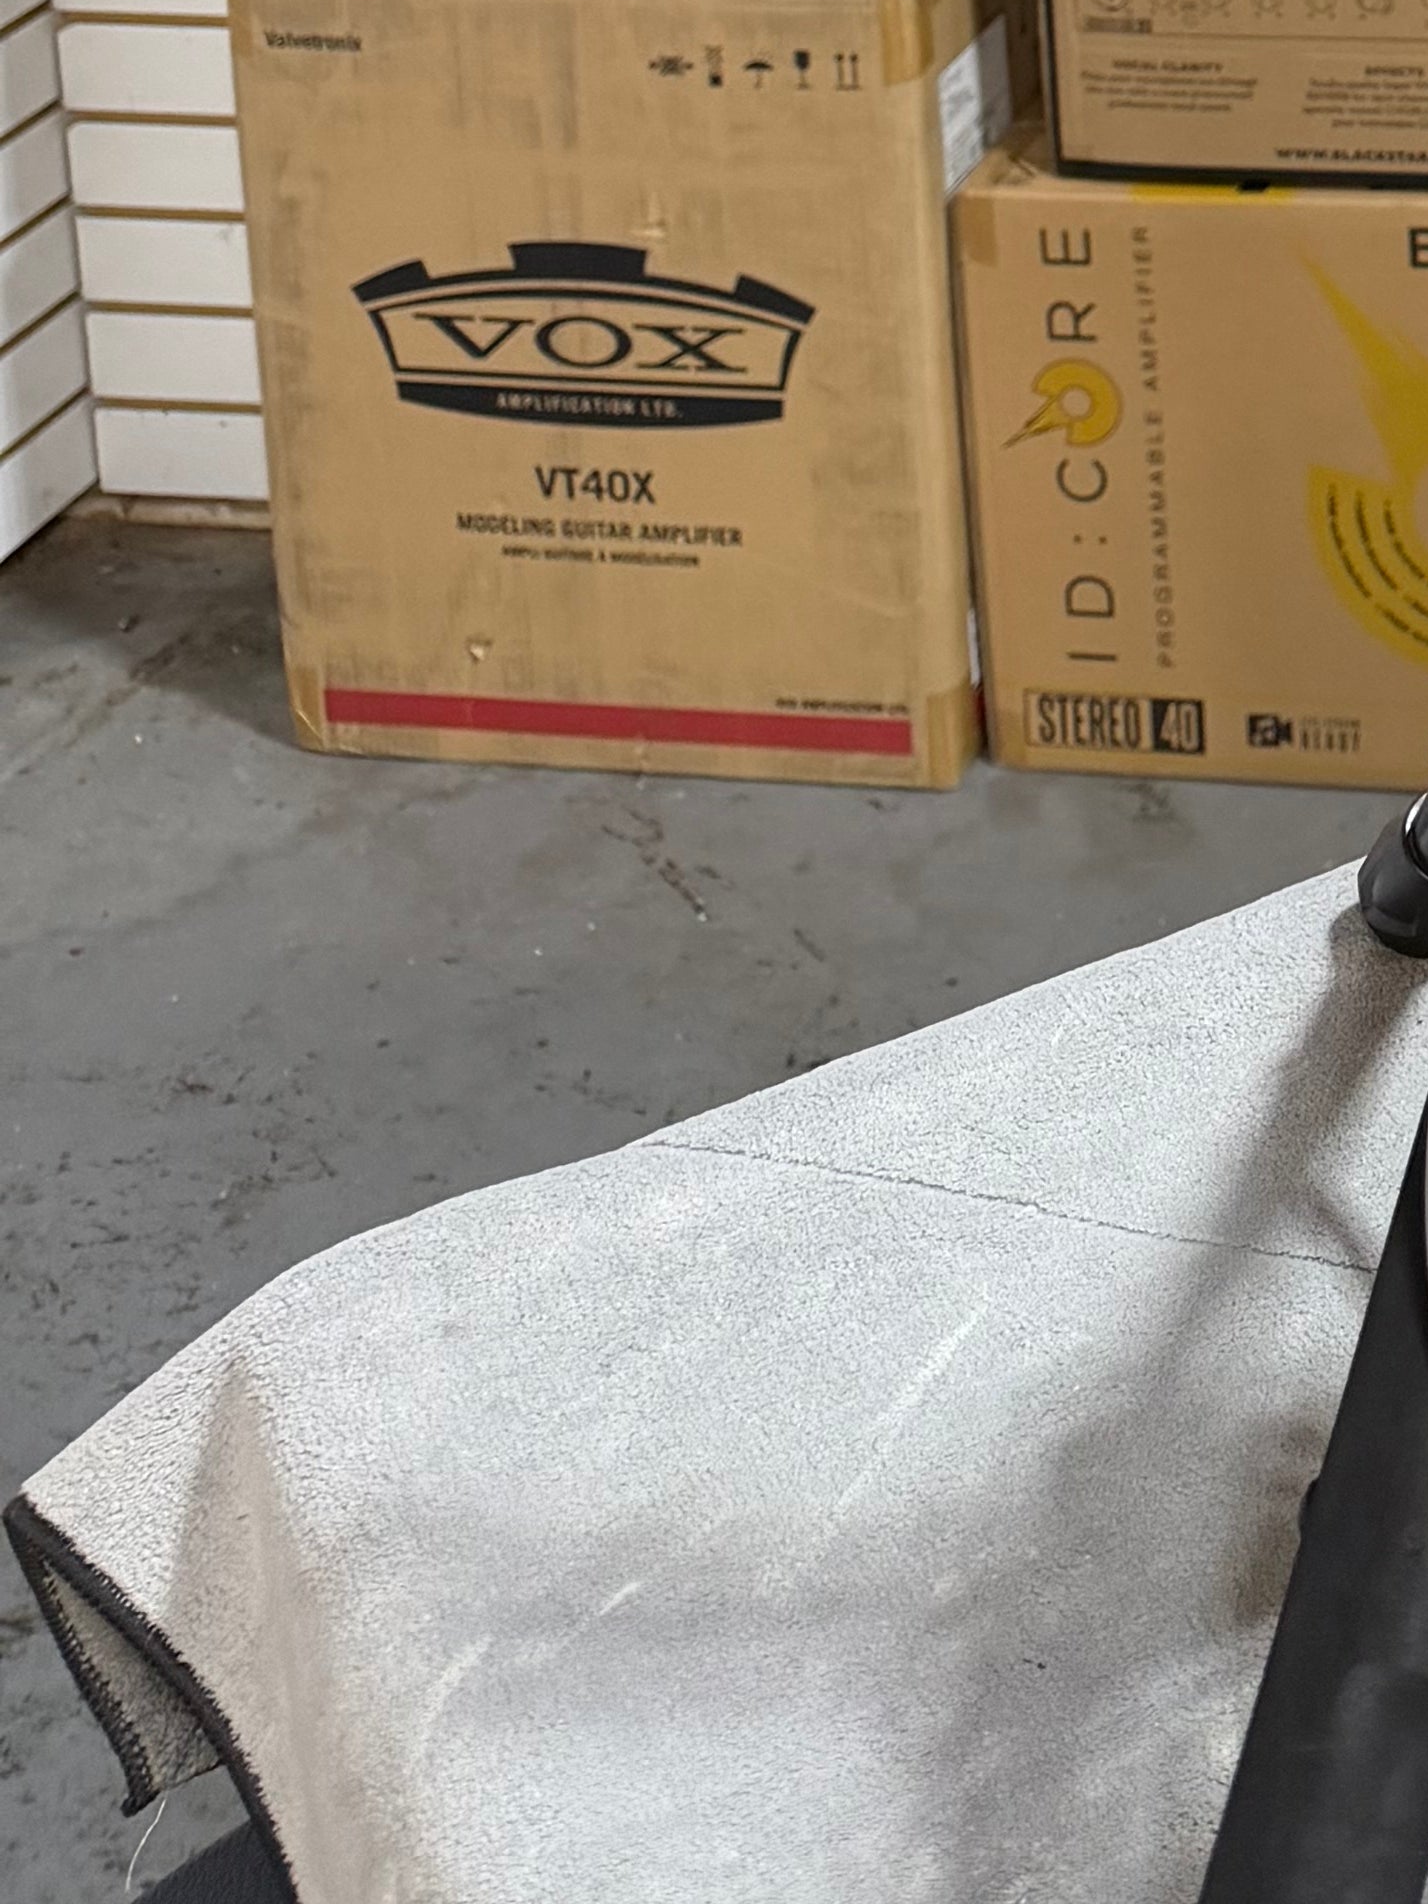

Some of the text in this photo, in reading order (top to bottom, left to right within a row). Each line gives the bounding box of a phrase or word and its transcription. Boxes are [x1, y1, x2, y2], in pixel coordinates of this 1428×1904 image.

[263, 29, 363, 53] Valvetronix
[415, 314, 749, 374] VOX
[495, 392, 636, 416] AMPLIFICATION
[1131, 223, 1174, 670] PROGRAMMABLE AMPLIFIER
[533, 463, 657, 506] VT40X
[455, 511, 744, 548] MODELING GUITAR AMPLIFIER
[1037, 693, 1141, 750] STEREO
